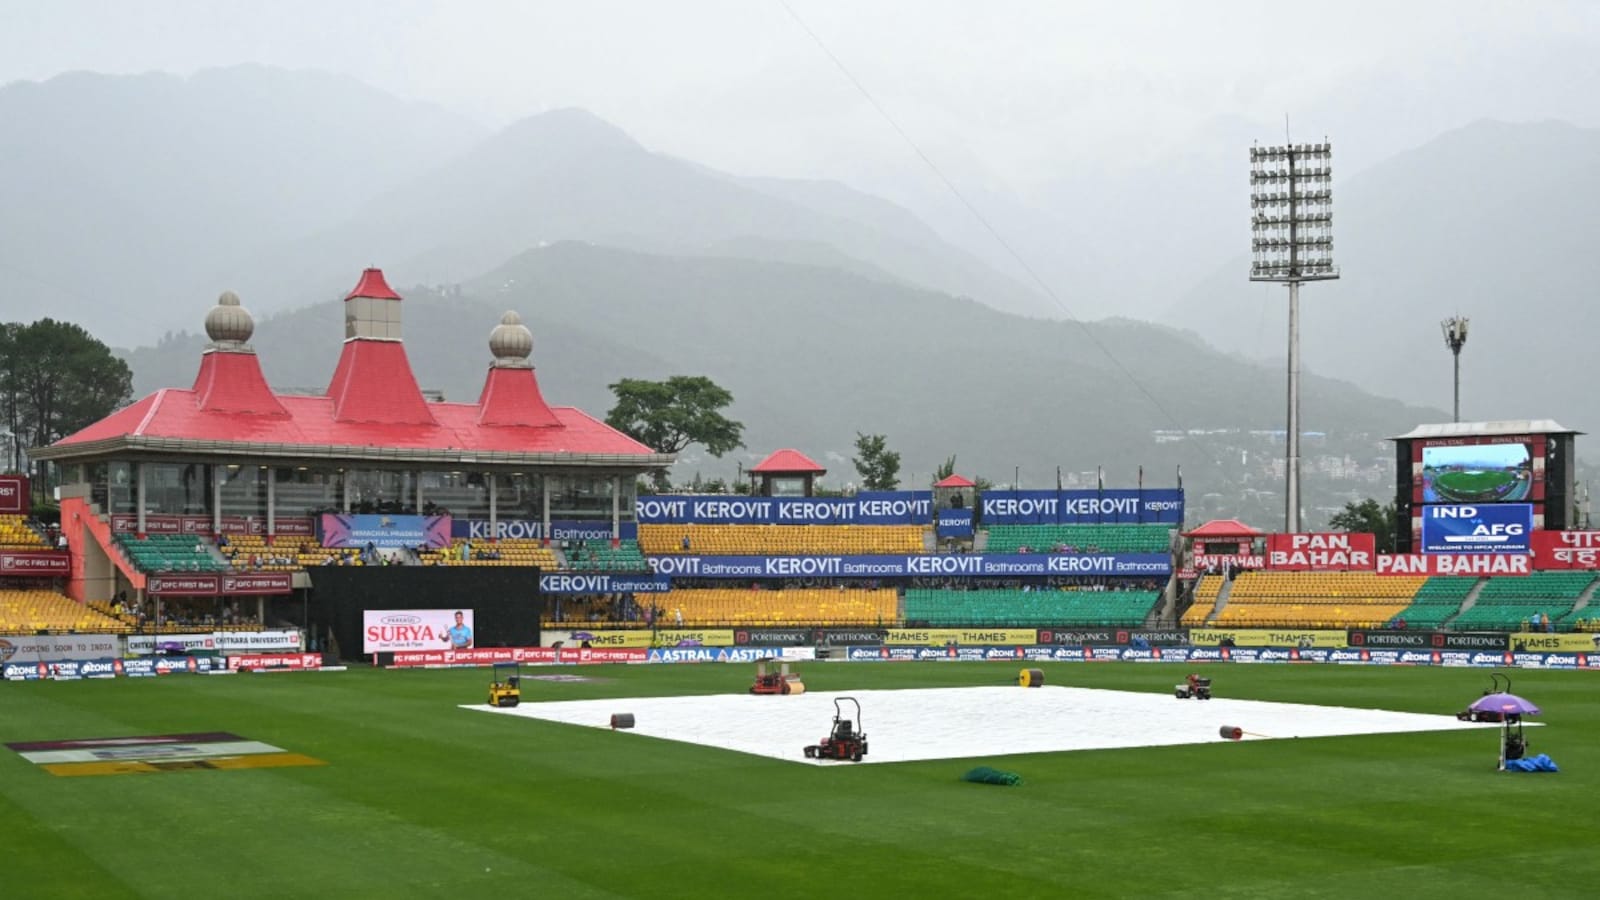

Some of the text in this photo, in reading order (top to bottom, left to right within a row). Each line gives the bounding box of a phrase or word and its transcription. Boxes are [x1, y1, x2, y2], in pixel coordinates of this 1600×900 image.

[694, 501, 772, 518] KEROVIT
[779, 502, 856, 519] KEROVIT
[859, 500, 930, 516] KEROVIT
[984, 499, 1058, 515] KEROVIT
[1066, 498, 1139, 515] KEROVIT
[1432, 507, 1478, 518] IND
[939, 518, 971, 526] KEROVIT
[1472, 524, 1523, 535] AFG
[1293, 536, 1348, 548] PAN
[1195, 556, 1218, 567] PAN
[1271, 551, 1369, 565] BAHAR
[702, 564, 761, 574] Bathrooms
[766, 557, 842, 574] KEROVIT
[843, 563, 902, 573] Bathrooms
[907, 556, 983, 573] KEROVIT
[985, 562, 1044, 572] Bathrooms
[1048, 557, 1115, 571] KEROVIT
[1116, 562, 1168, 571] Bathrooms
[1377, 555, 1527, 573] PAN BAHAR
[540, 576, 668, 591] KEROVIT Bathrooms
[368, 625, 434, 642] SURYA
[659, 633, 704, 642] THAMES
[751, 632, 804, 641] PORTRONICS
[885, 632, 928, 640] THAMES
[962, 632, 1006, 641] THAMES
[1191, 633, 1235, 642] THAMES
[1269, 633, 1315, 642] THAMES
[1368, 635, 1423, 644] PORTRONICS
[1448, 637, 1505, 646] PORTRONICS
[1512, 638, 1560, 648] THAMES
[404, 654, 424, 662] FIRST
[425, 653, 442, 661] Bank
[663, 650, 713, 660] ASTRAL
